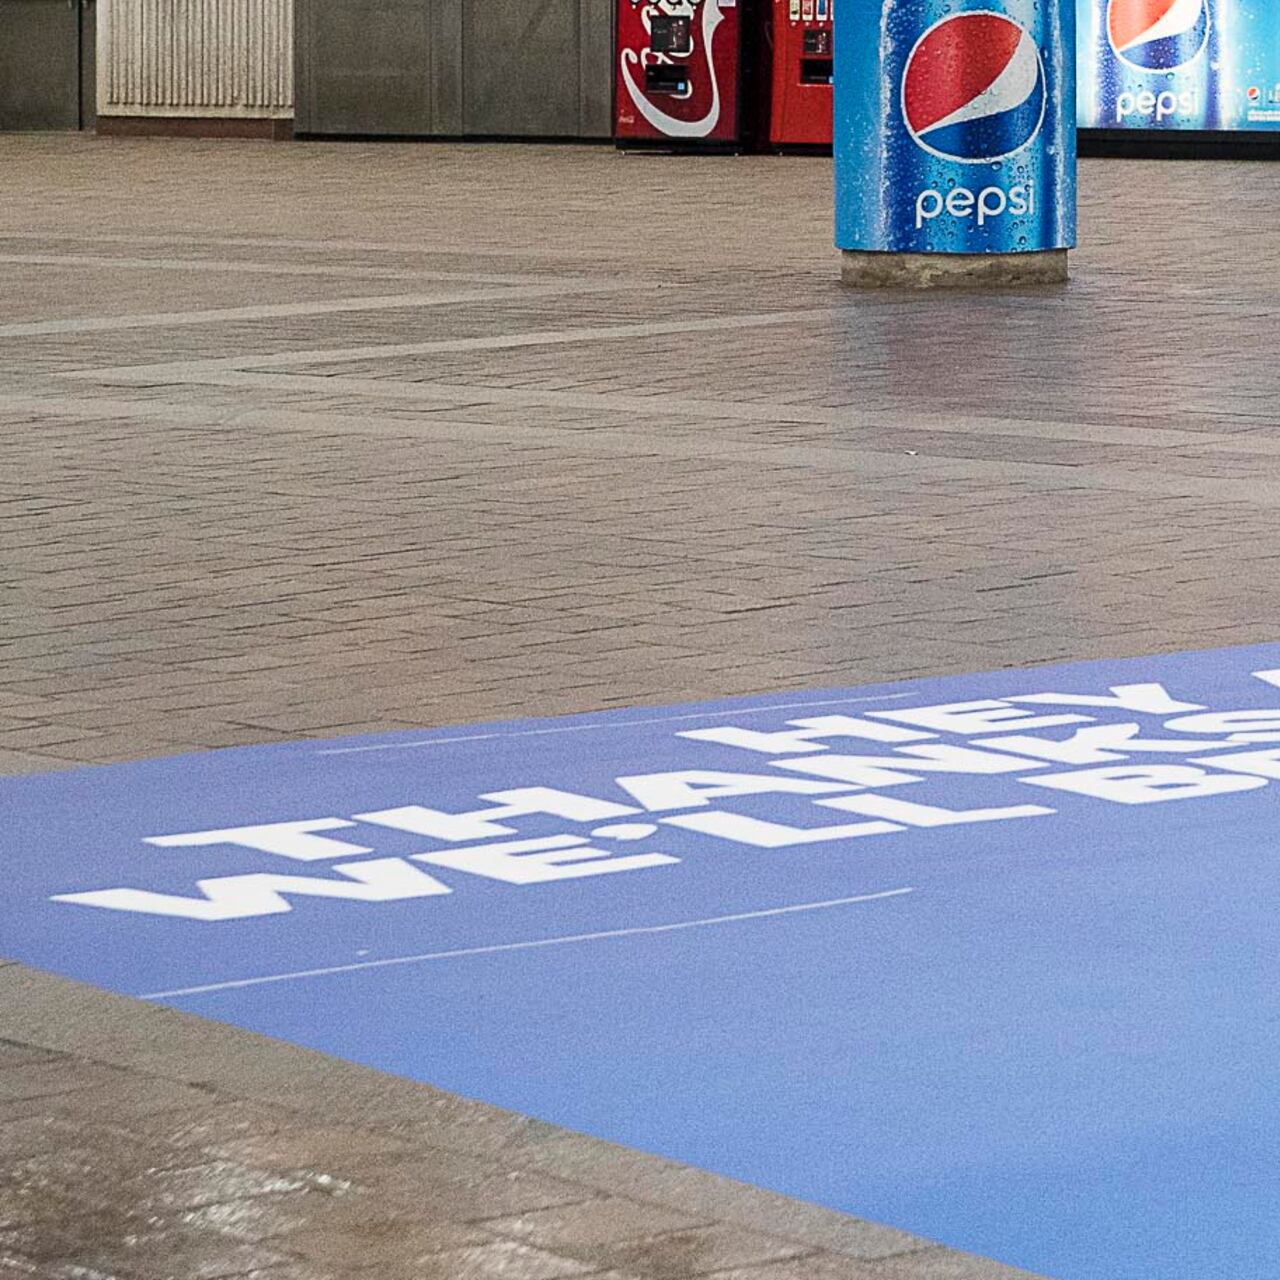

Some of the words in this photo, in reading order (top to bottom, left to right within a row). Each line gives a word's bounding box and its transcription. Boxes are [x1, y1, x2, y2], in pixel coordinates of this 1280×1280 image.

[1115, 83, 1199, 122] pepsi
[914, 178, 1035, 228] pepsi
[674, 683, 1209, 754] HEY
[48, 793, 1058, 921] WE'LL
